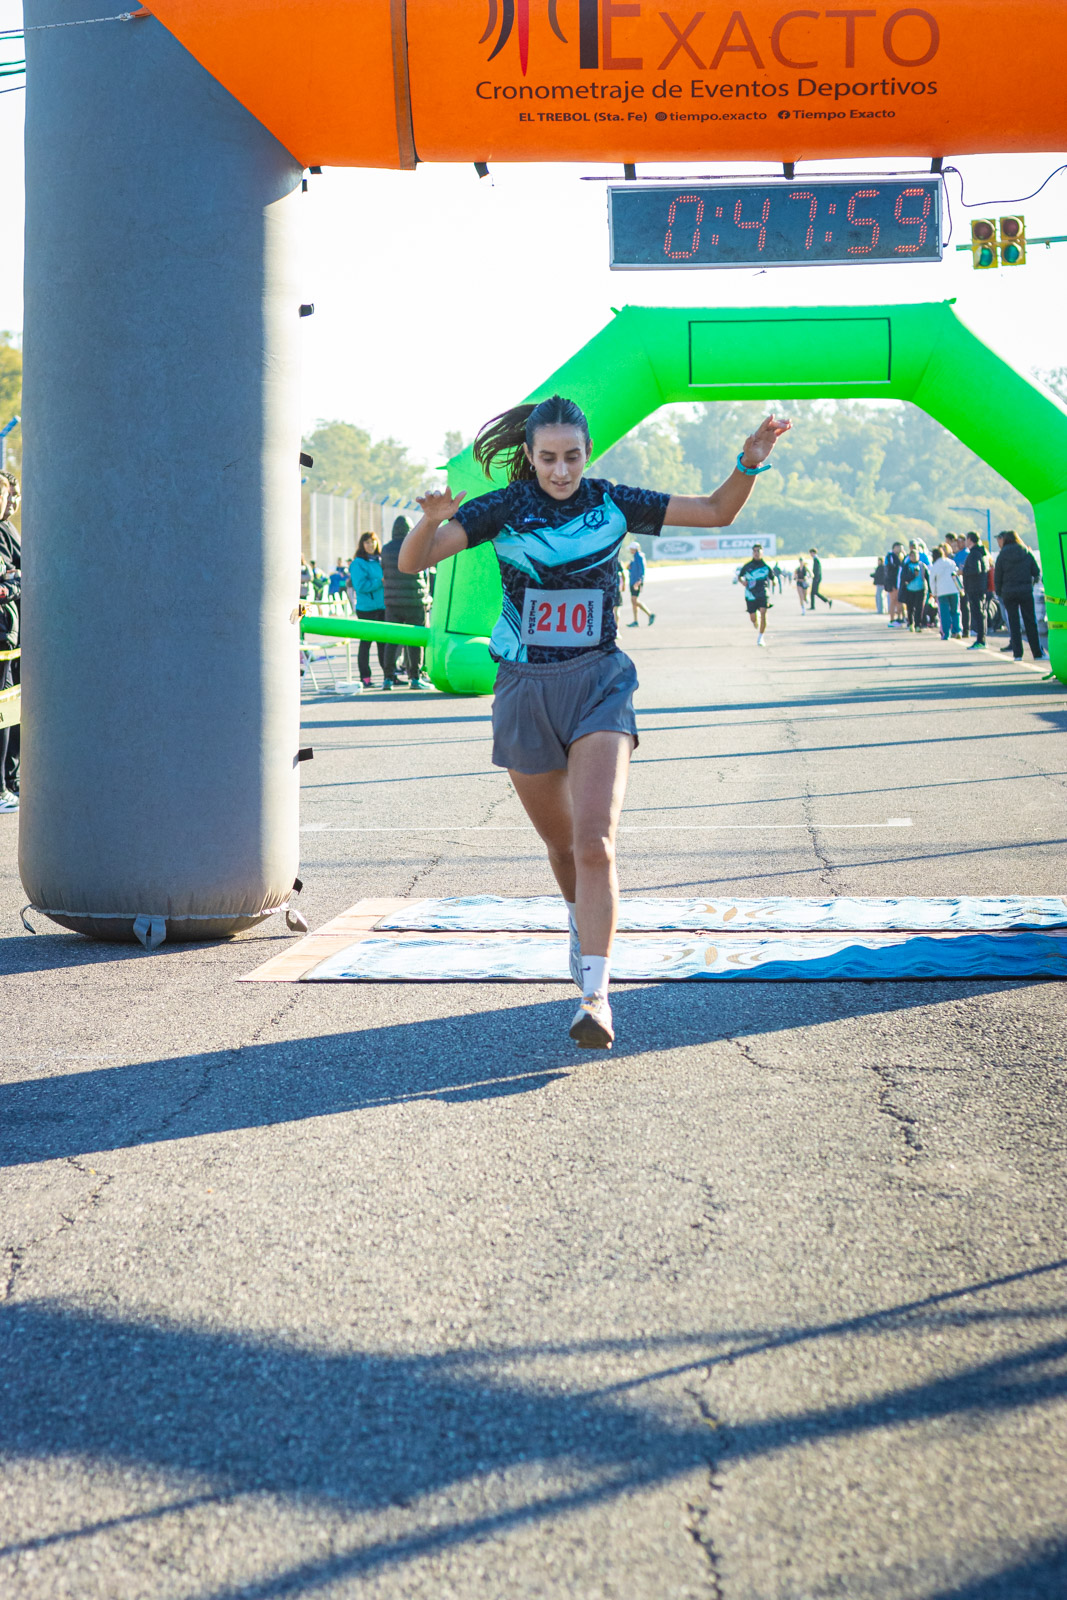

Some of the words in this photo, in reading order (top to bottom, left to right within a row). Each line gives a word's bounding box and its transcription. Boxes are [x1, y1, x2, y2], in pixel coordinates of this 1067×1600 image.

[476, 81, 644, 103] Cronometraje
[652, 79, 682, 98] de
[691, 79, 789, 98] Eventos
[798, 77, 937, 100] Deportivos
[519, 112, 535, 122] EL
[537, 112, 590, 122] TREBOL
[594, 112, 624, 123] (Sta.
[628, 112, 647, 122] Fe)
[670, 111, 767, 122] tiempo.exacto
[793, 110, 846, 121] Tiempo
[850, 109, 895, 119] Exacto
[528, 600, 537, 635] TIEMPO
[536, 602, 587, 634] 210
